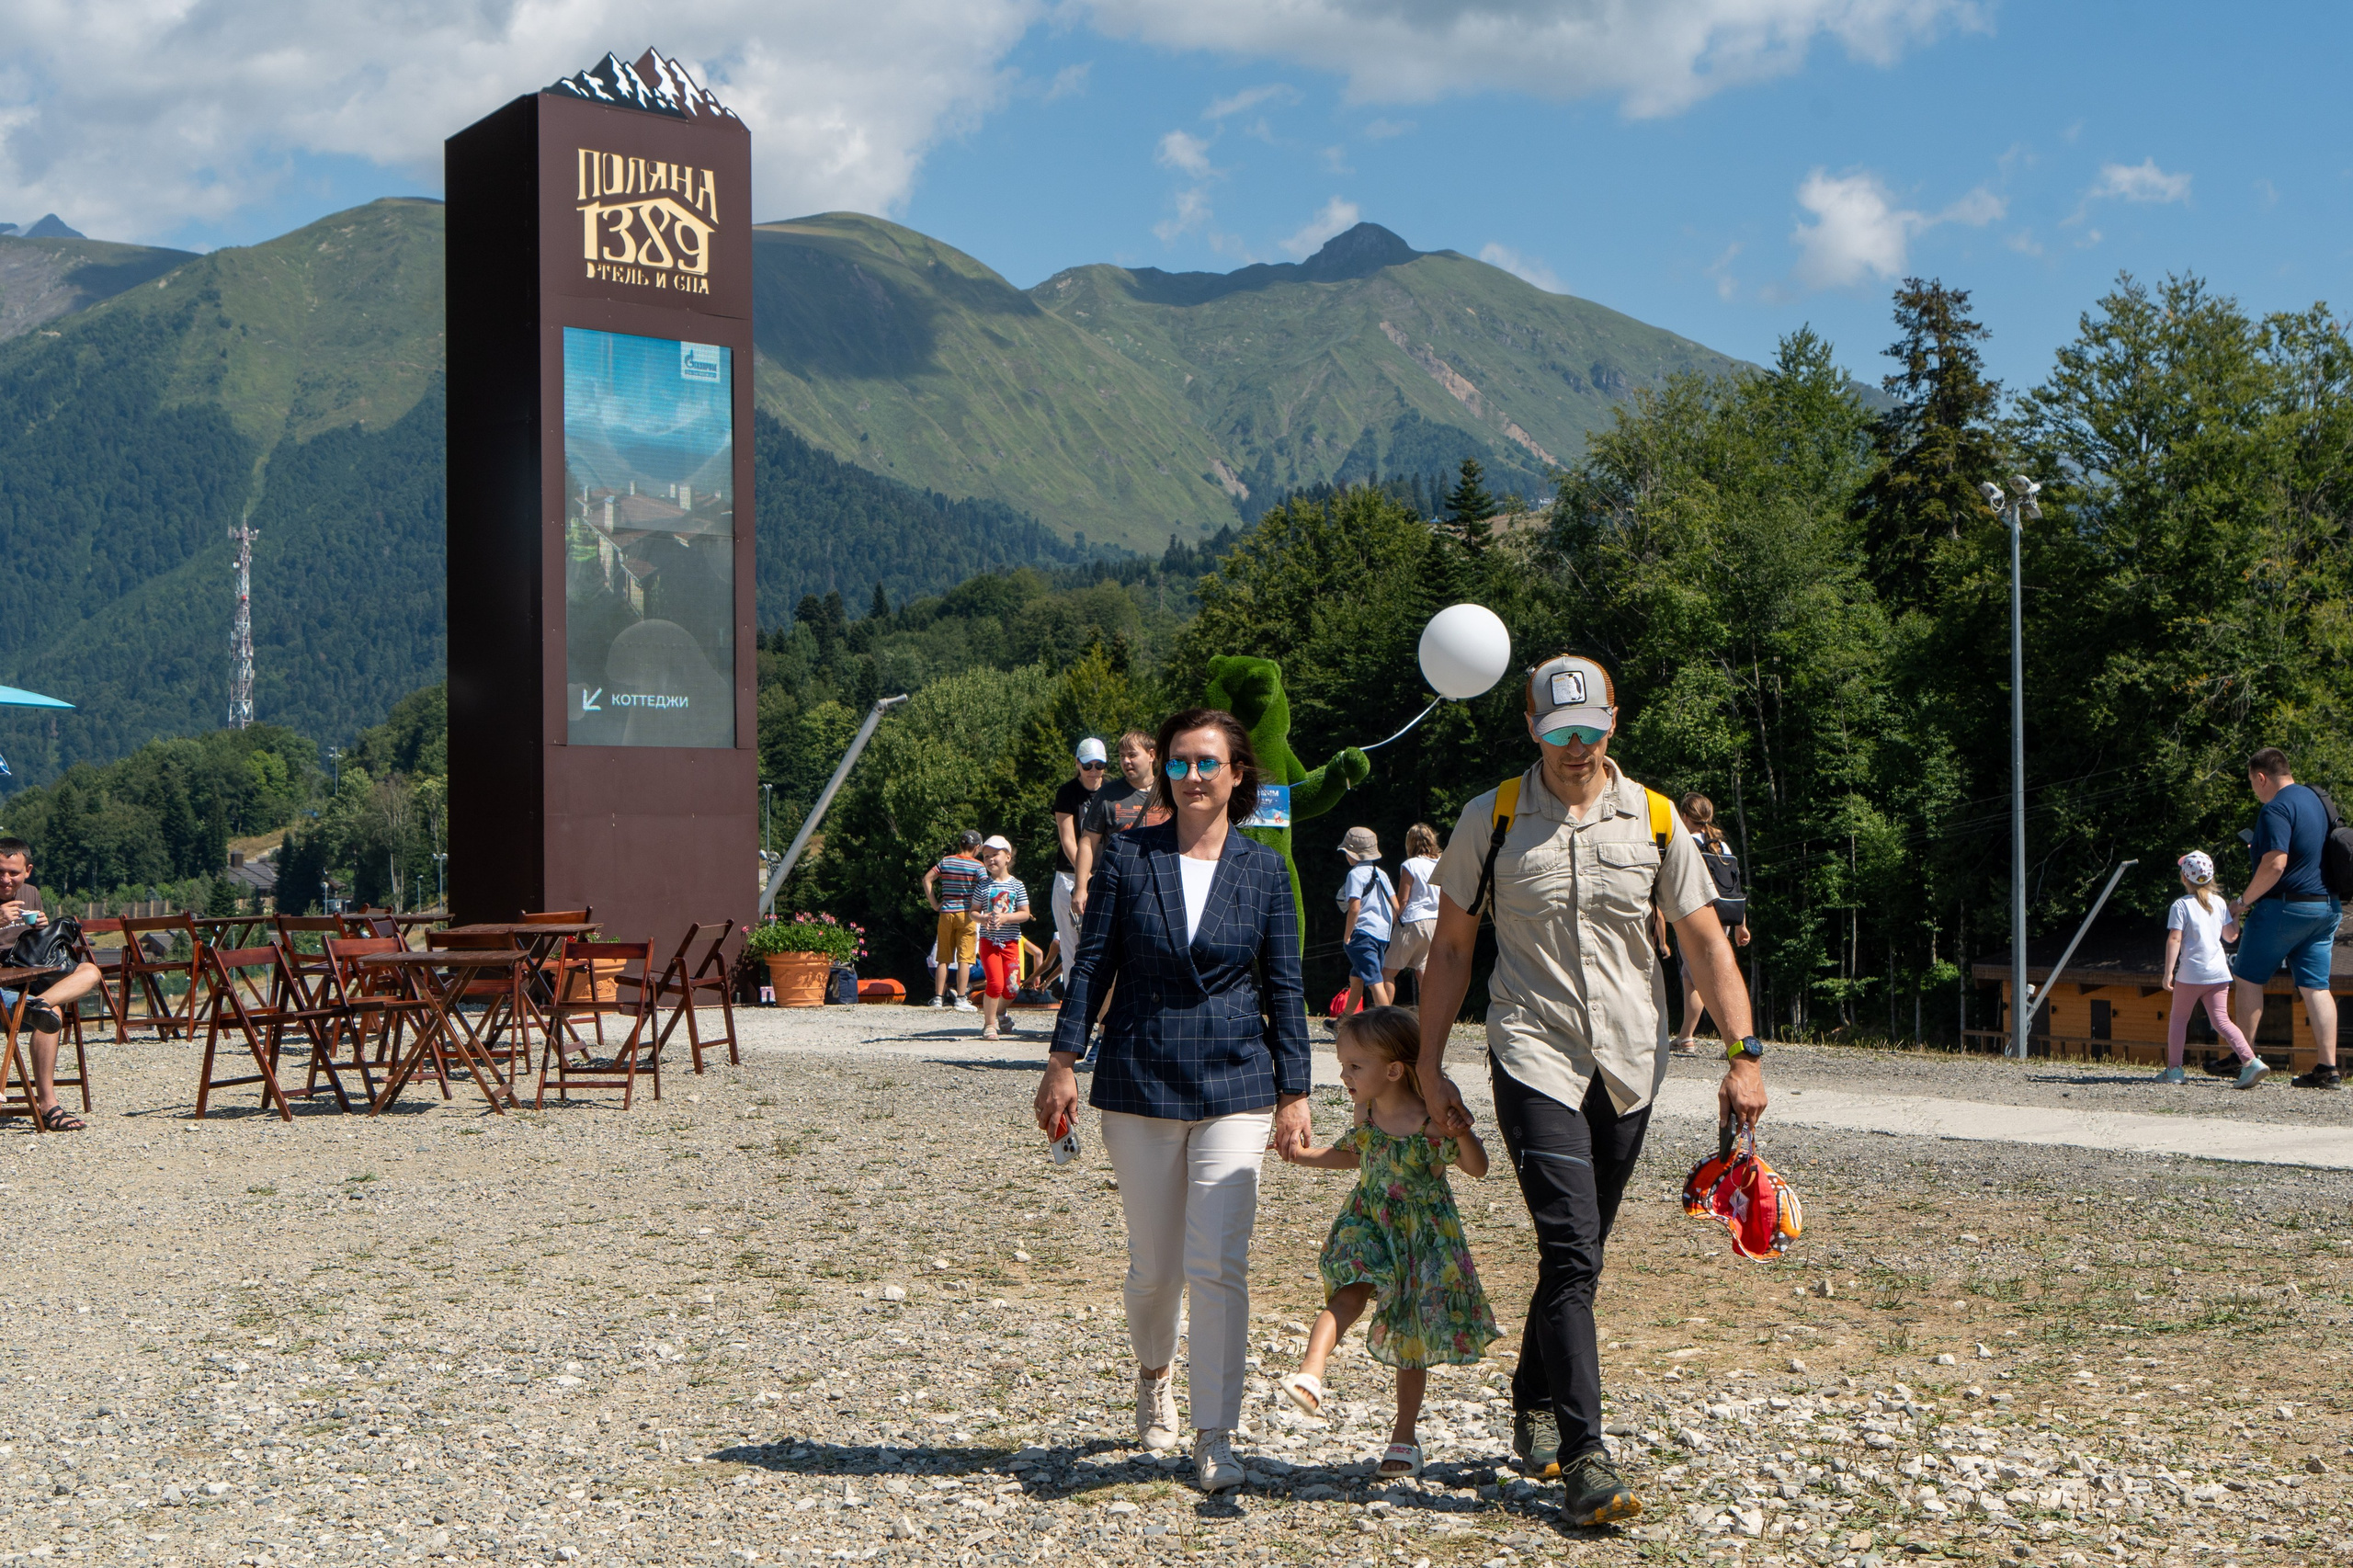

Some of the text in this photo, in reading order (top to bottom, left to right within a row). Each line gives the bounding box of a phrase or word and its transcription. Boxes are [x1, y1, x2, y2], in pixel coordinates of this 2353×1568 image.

[577, 148, 719, 224] ПОЛЯНА
[577, 199, 711, 275] 1389
[655, 271, 666, 289] И
[674, 274, 710, 294] СПА
[611, 693, 688, 709] КОТТЕДЖИ
